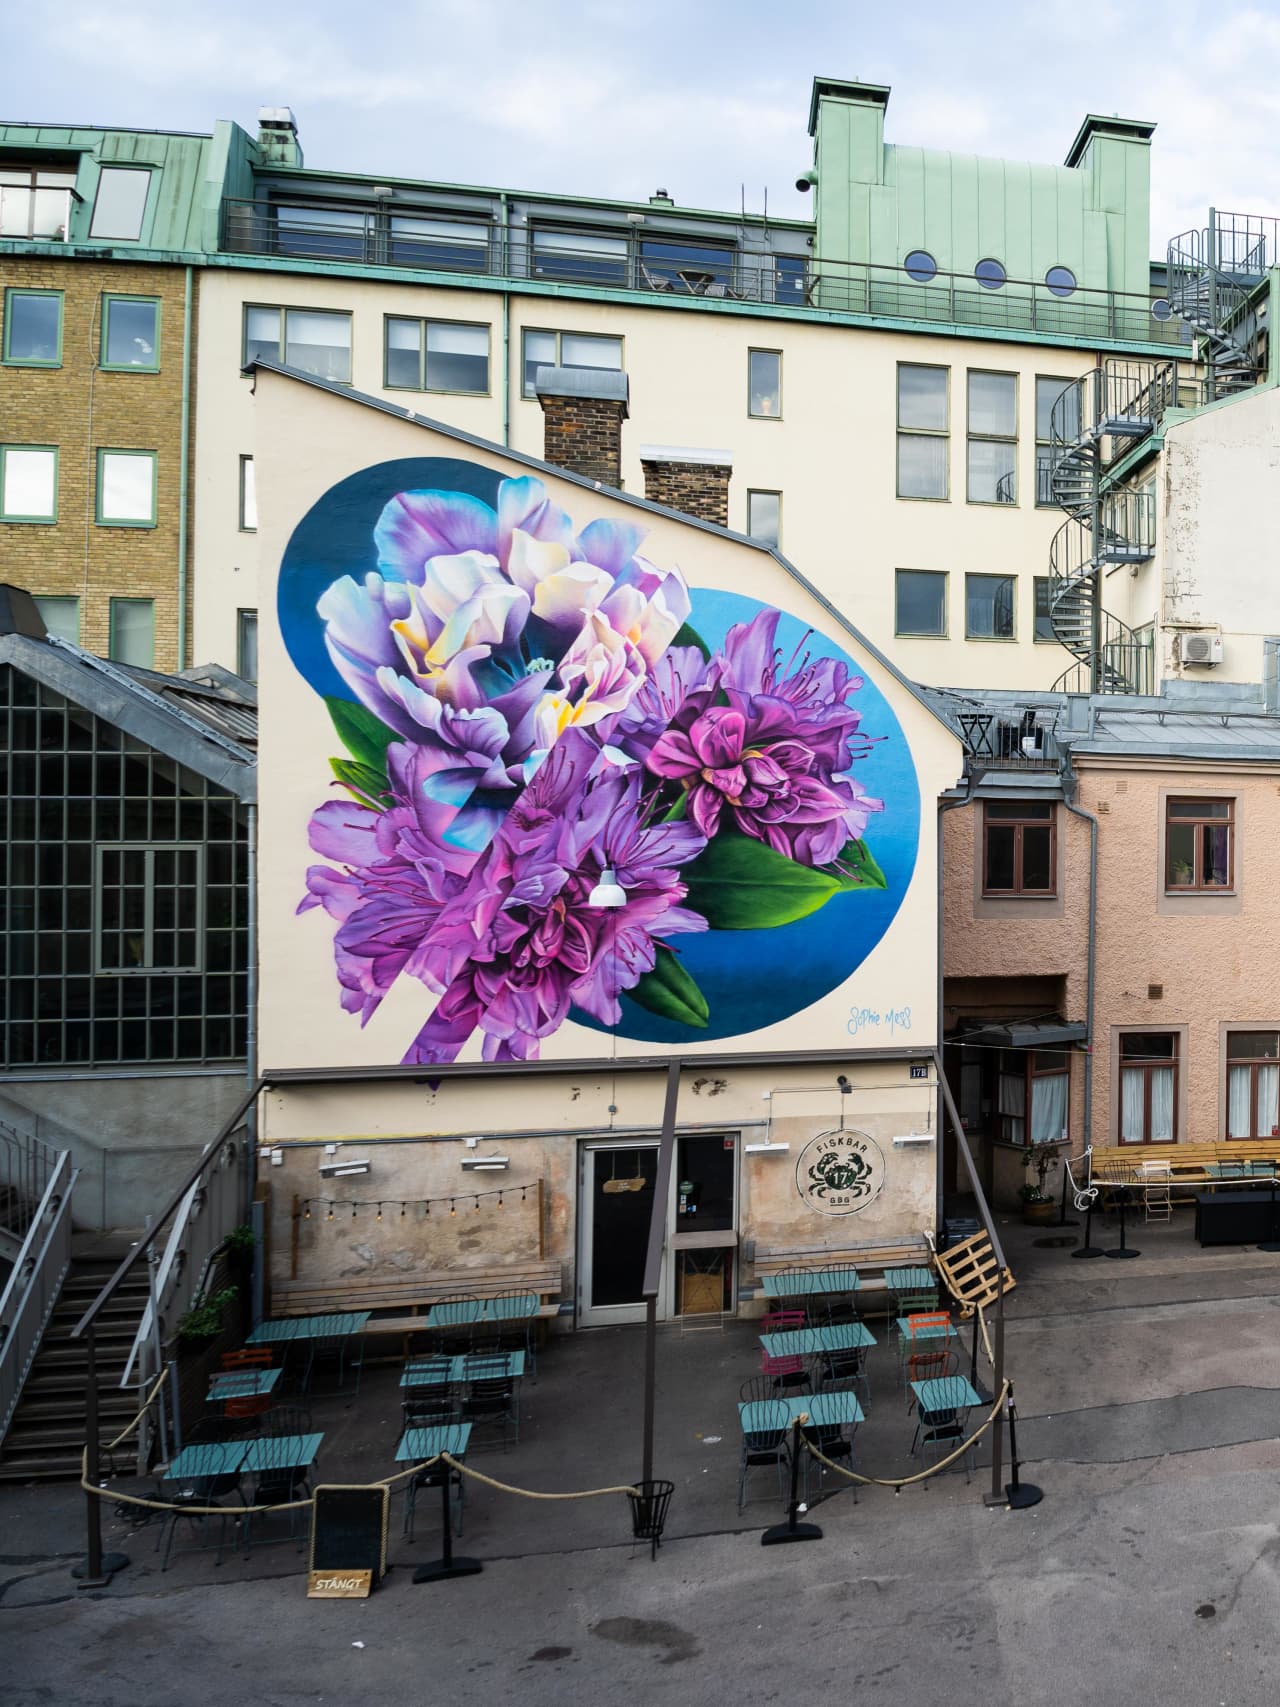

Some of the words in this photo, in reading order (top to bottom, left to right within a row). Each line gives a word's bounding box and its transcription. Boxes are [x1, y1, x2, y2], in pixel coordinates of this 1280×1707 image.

[816, 1137, 868, 1153] FISKBAR
[833, 1171, 848, 1185] 17
[830, 1196, 850, 1204] GBG
